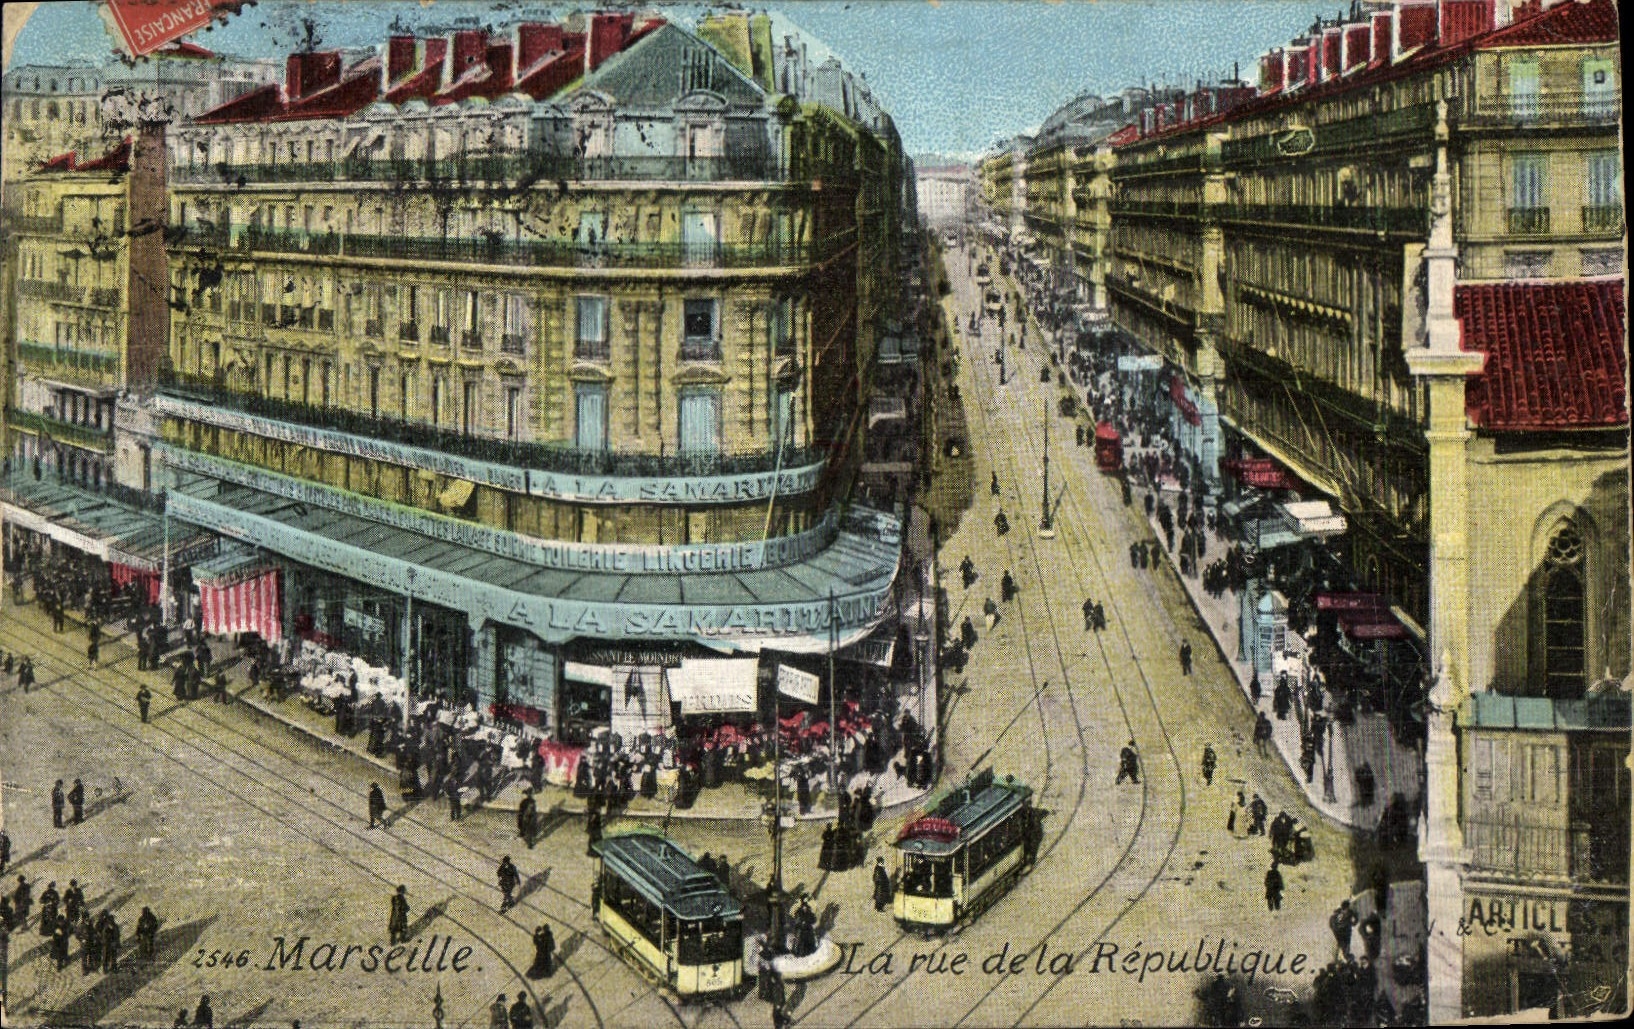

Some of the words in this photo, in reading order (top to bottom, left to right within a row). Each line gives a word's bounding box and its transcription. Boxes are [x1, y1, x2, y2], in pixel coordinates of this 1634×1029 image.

[542, 475, 562, 497] A
[574, 478, 623, 501] LA
[540, 545, 628, 572] TOILERIE
[641, 547, 753, 572] LINGERIE
[507, 597, 535, 626] A
[548, 603, 607, 635] LA
